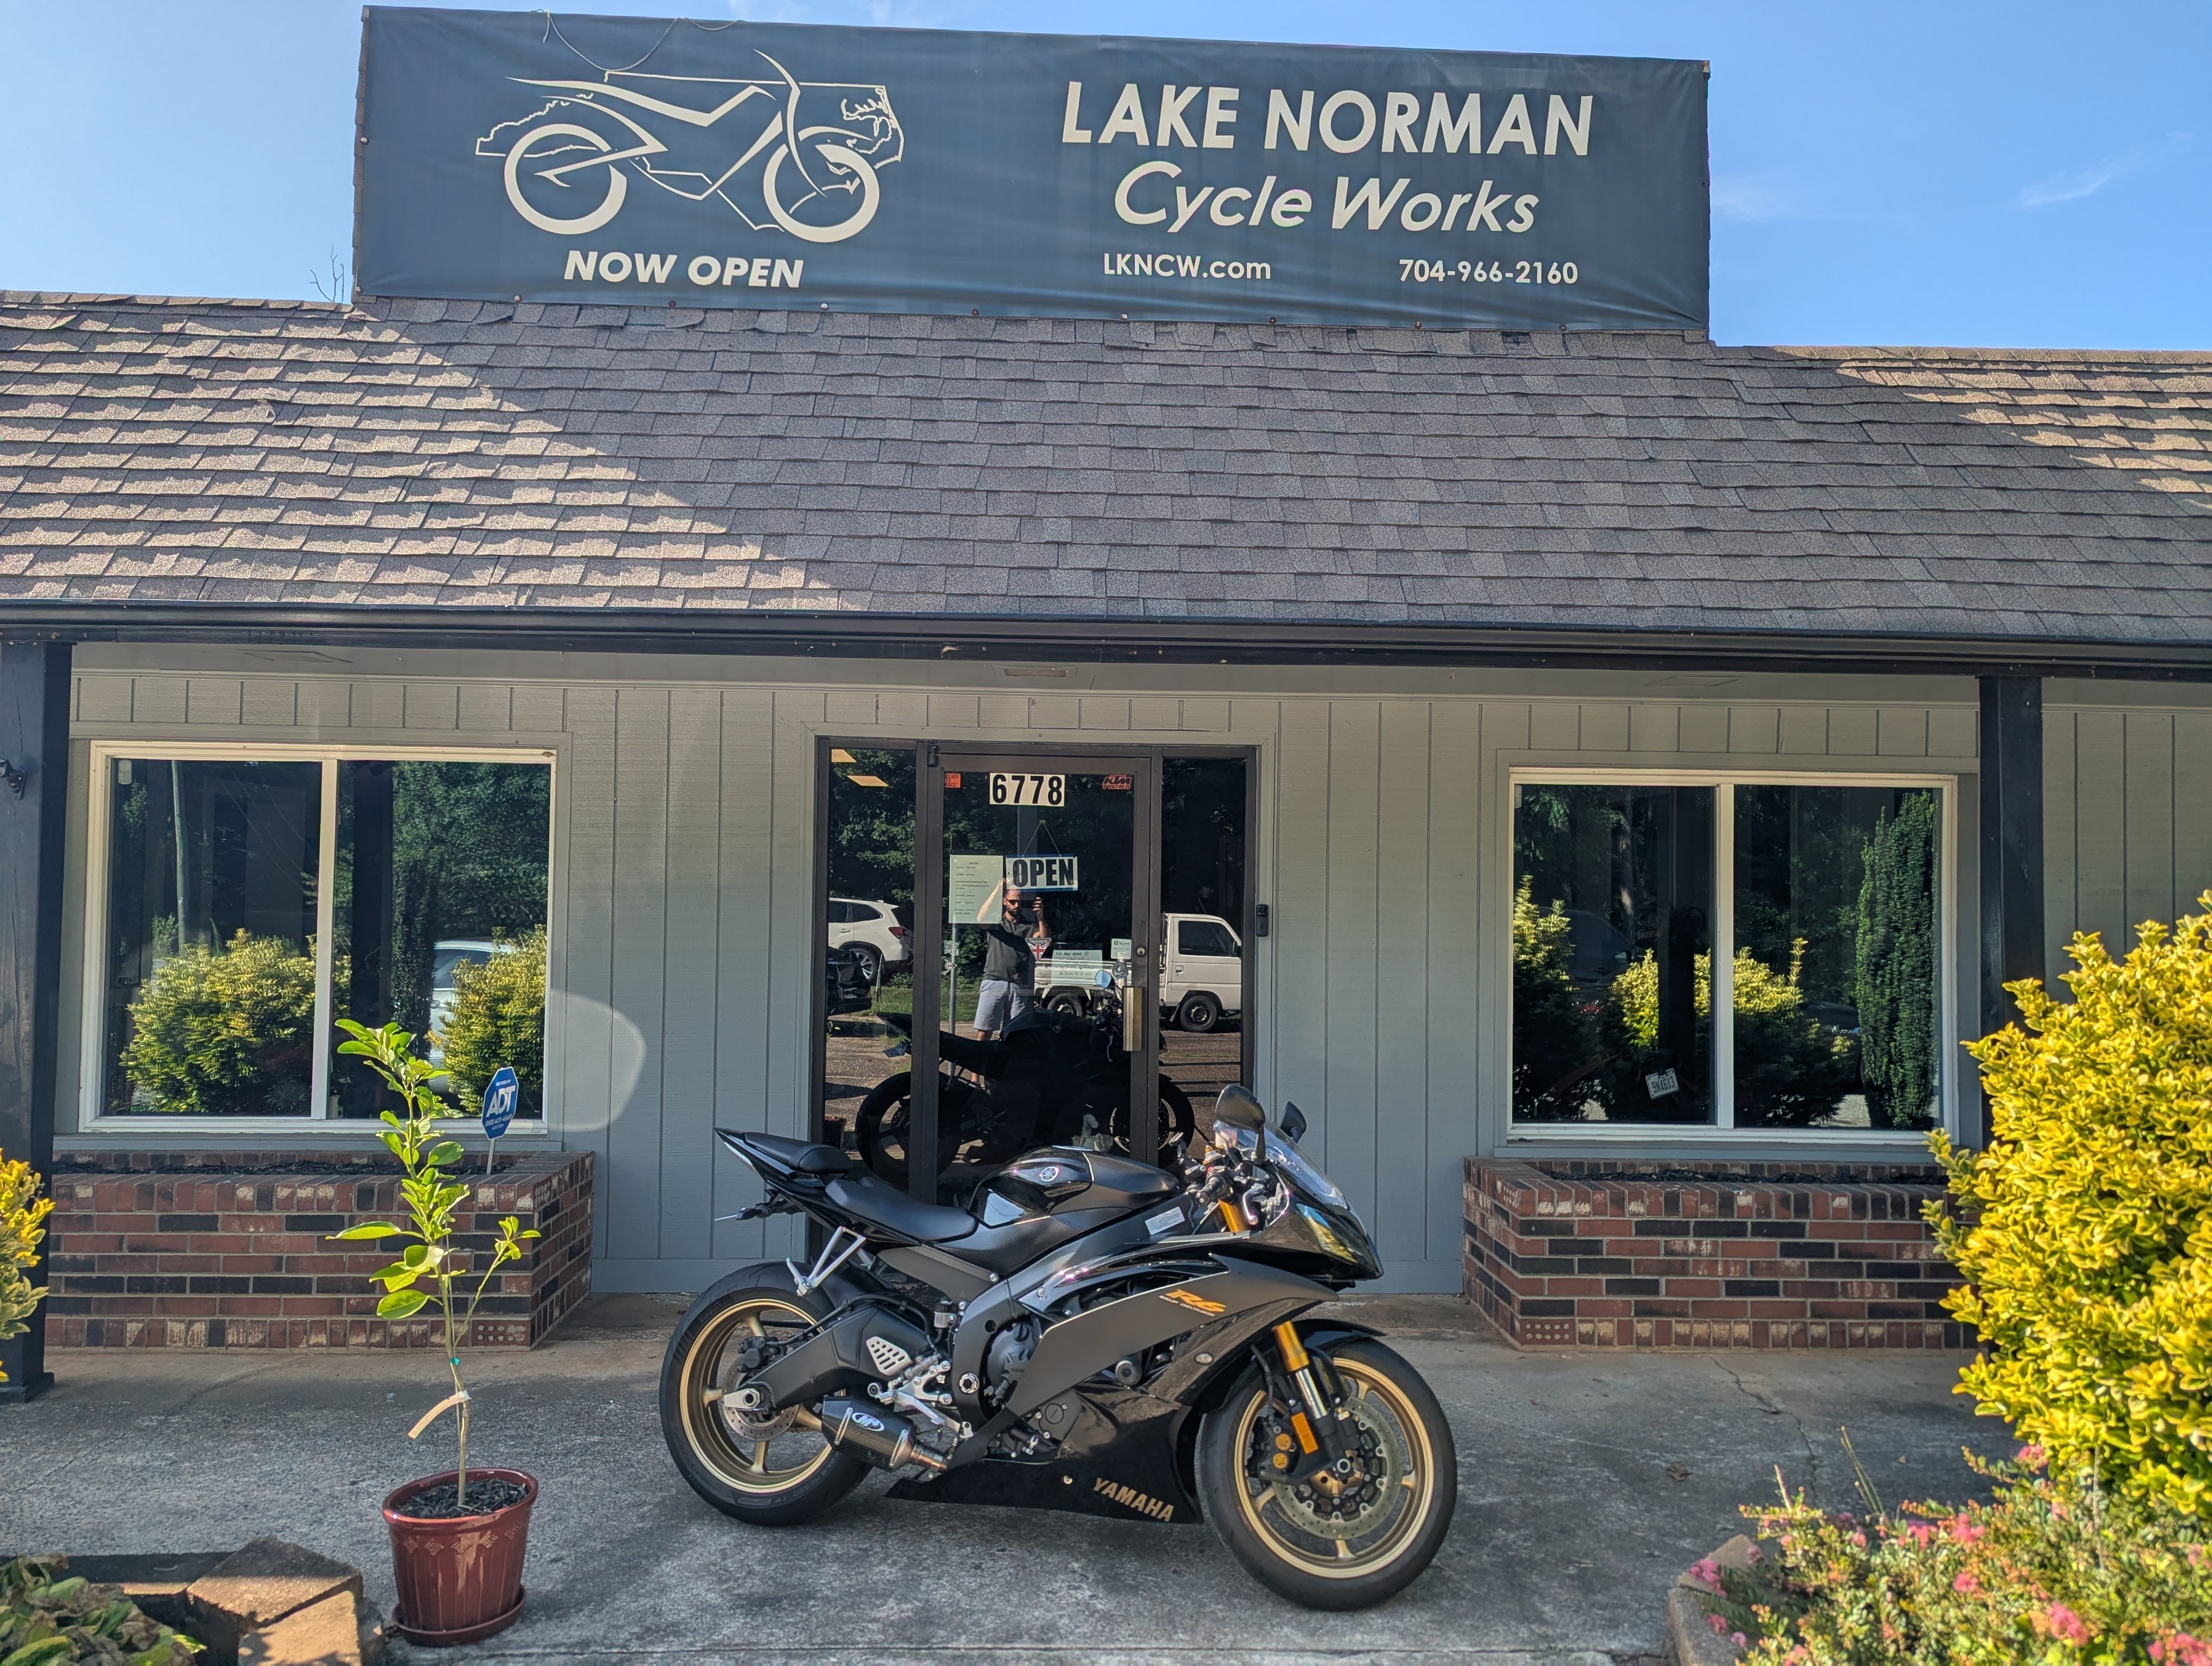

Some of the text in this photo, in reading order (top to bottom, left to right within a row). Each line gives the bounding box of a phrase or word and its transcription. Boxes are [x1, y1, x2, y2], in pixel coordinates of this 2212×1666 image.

[1062, 81, 1593, 156] LAKE NORMAN
[1114, 161, 1539, 233] Cycle Works
[564, 250, 804, 288] NOW OPEN
[1104, 253, 1271, 280] LKNCW.com
[1399, 259, 1578, 284] 704-966-2160
[993, 774, 1062, 805] 6778
[1103, 776, 1131, 784] KTM
[1013, 859, 1074, 887] OPEN
[486, 1085, 516, 1118] ADT
[1166, 1289, 1227, 1312] R6
[1093, 1477, 1174, 1522] YAMAHA
